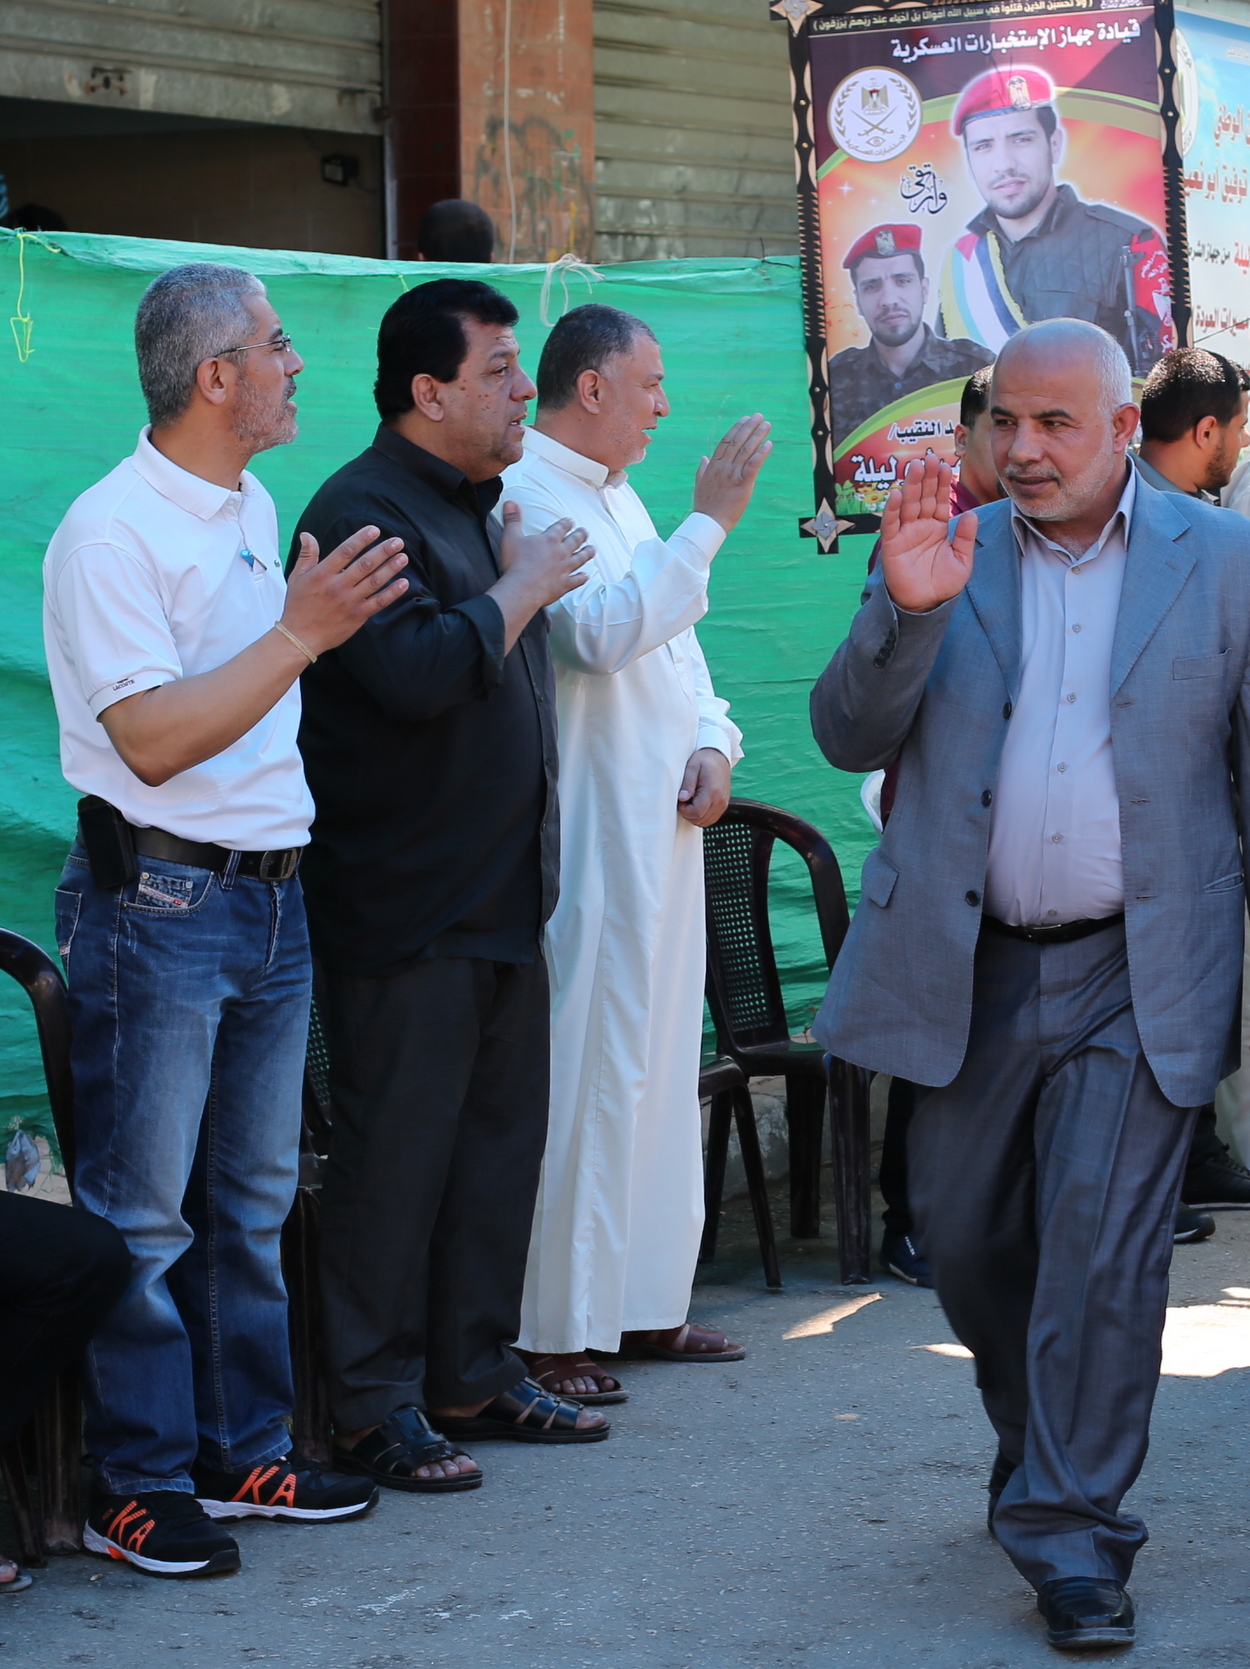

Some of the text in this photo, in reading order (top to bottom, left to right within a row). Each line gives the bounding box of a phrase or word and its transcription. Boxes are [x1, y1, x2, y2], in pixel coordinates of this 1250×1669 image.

[1057, 25, 1095, 48] جهاز
[1096, 18, 1142, 43] قيادة
[890, 36, 962, 63] العسكرية
[1214, 104, 1245, 147] الوطني
[1184, 160, 1204, 197] نعي
[1233, 241, 1250, 275] ليلة
[851, 453, 899, 490] ليلة
